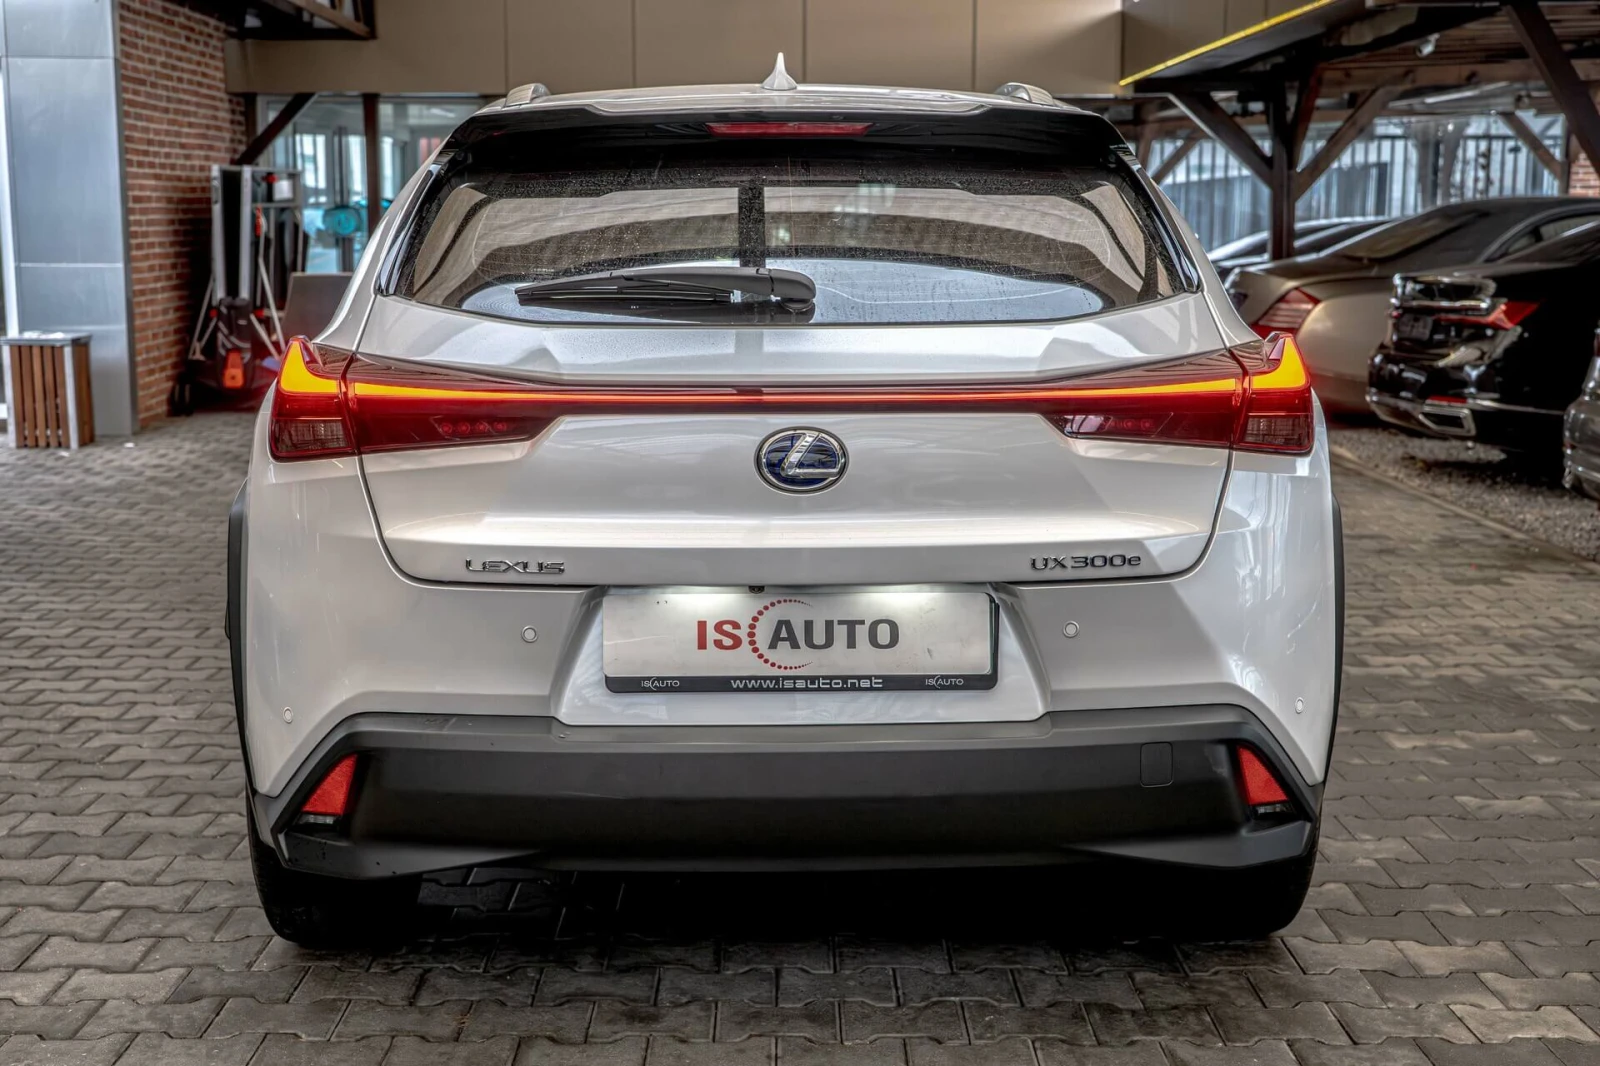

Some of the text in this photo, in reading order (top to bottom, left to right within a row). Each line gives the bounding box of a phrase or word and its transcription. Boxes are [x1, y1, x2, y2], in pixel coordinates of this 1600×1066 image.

[465, 558, 566, 574] LEXUS
[1030, 554, 1142, 571] UX300e
[696, 618, 900, 651] IS AUTO
[730, 677, 884, 689] www.isauto.net
